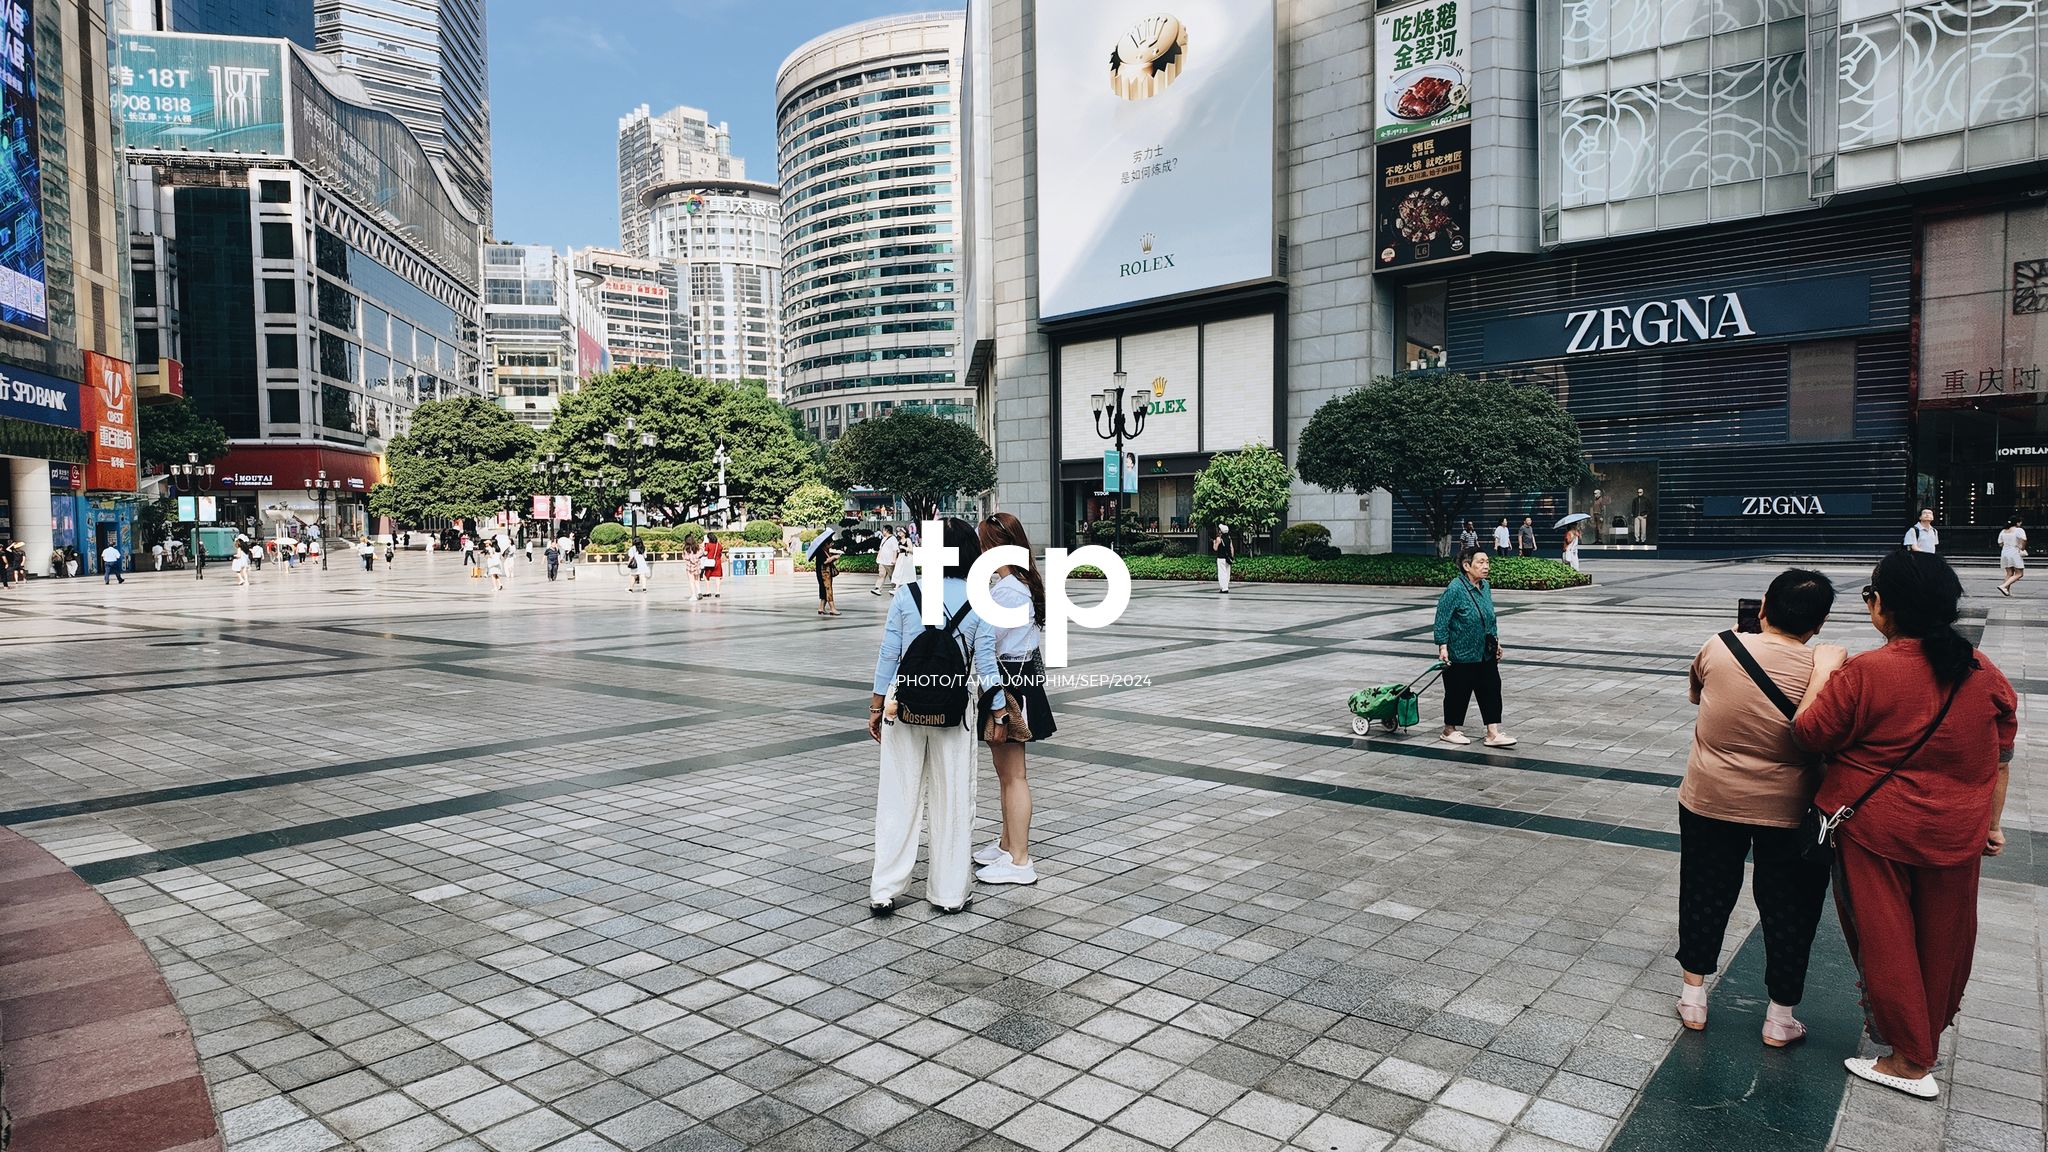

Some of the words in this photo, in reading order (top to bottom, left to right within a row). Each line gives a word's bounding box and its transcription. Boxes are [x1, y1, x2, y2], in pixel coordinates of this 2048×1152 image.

[153, 96, 192, 113] 1818
[1132, 144, 1164, 164] 劳力士
[1120, 253, 1175, 278] ROLEX
[1564, 292, 1756, 355] ZEGNA
[1140, 398, 1187, 416] OLEX
[1741, 495, 1826, 516] ZEGNA
[902, 708, 946, 725] MOSCHINO
